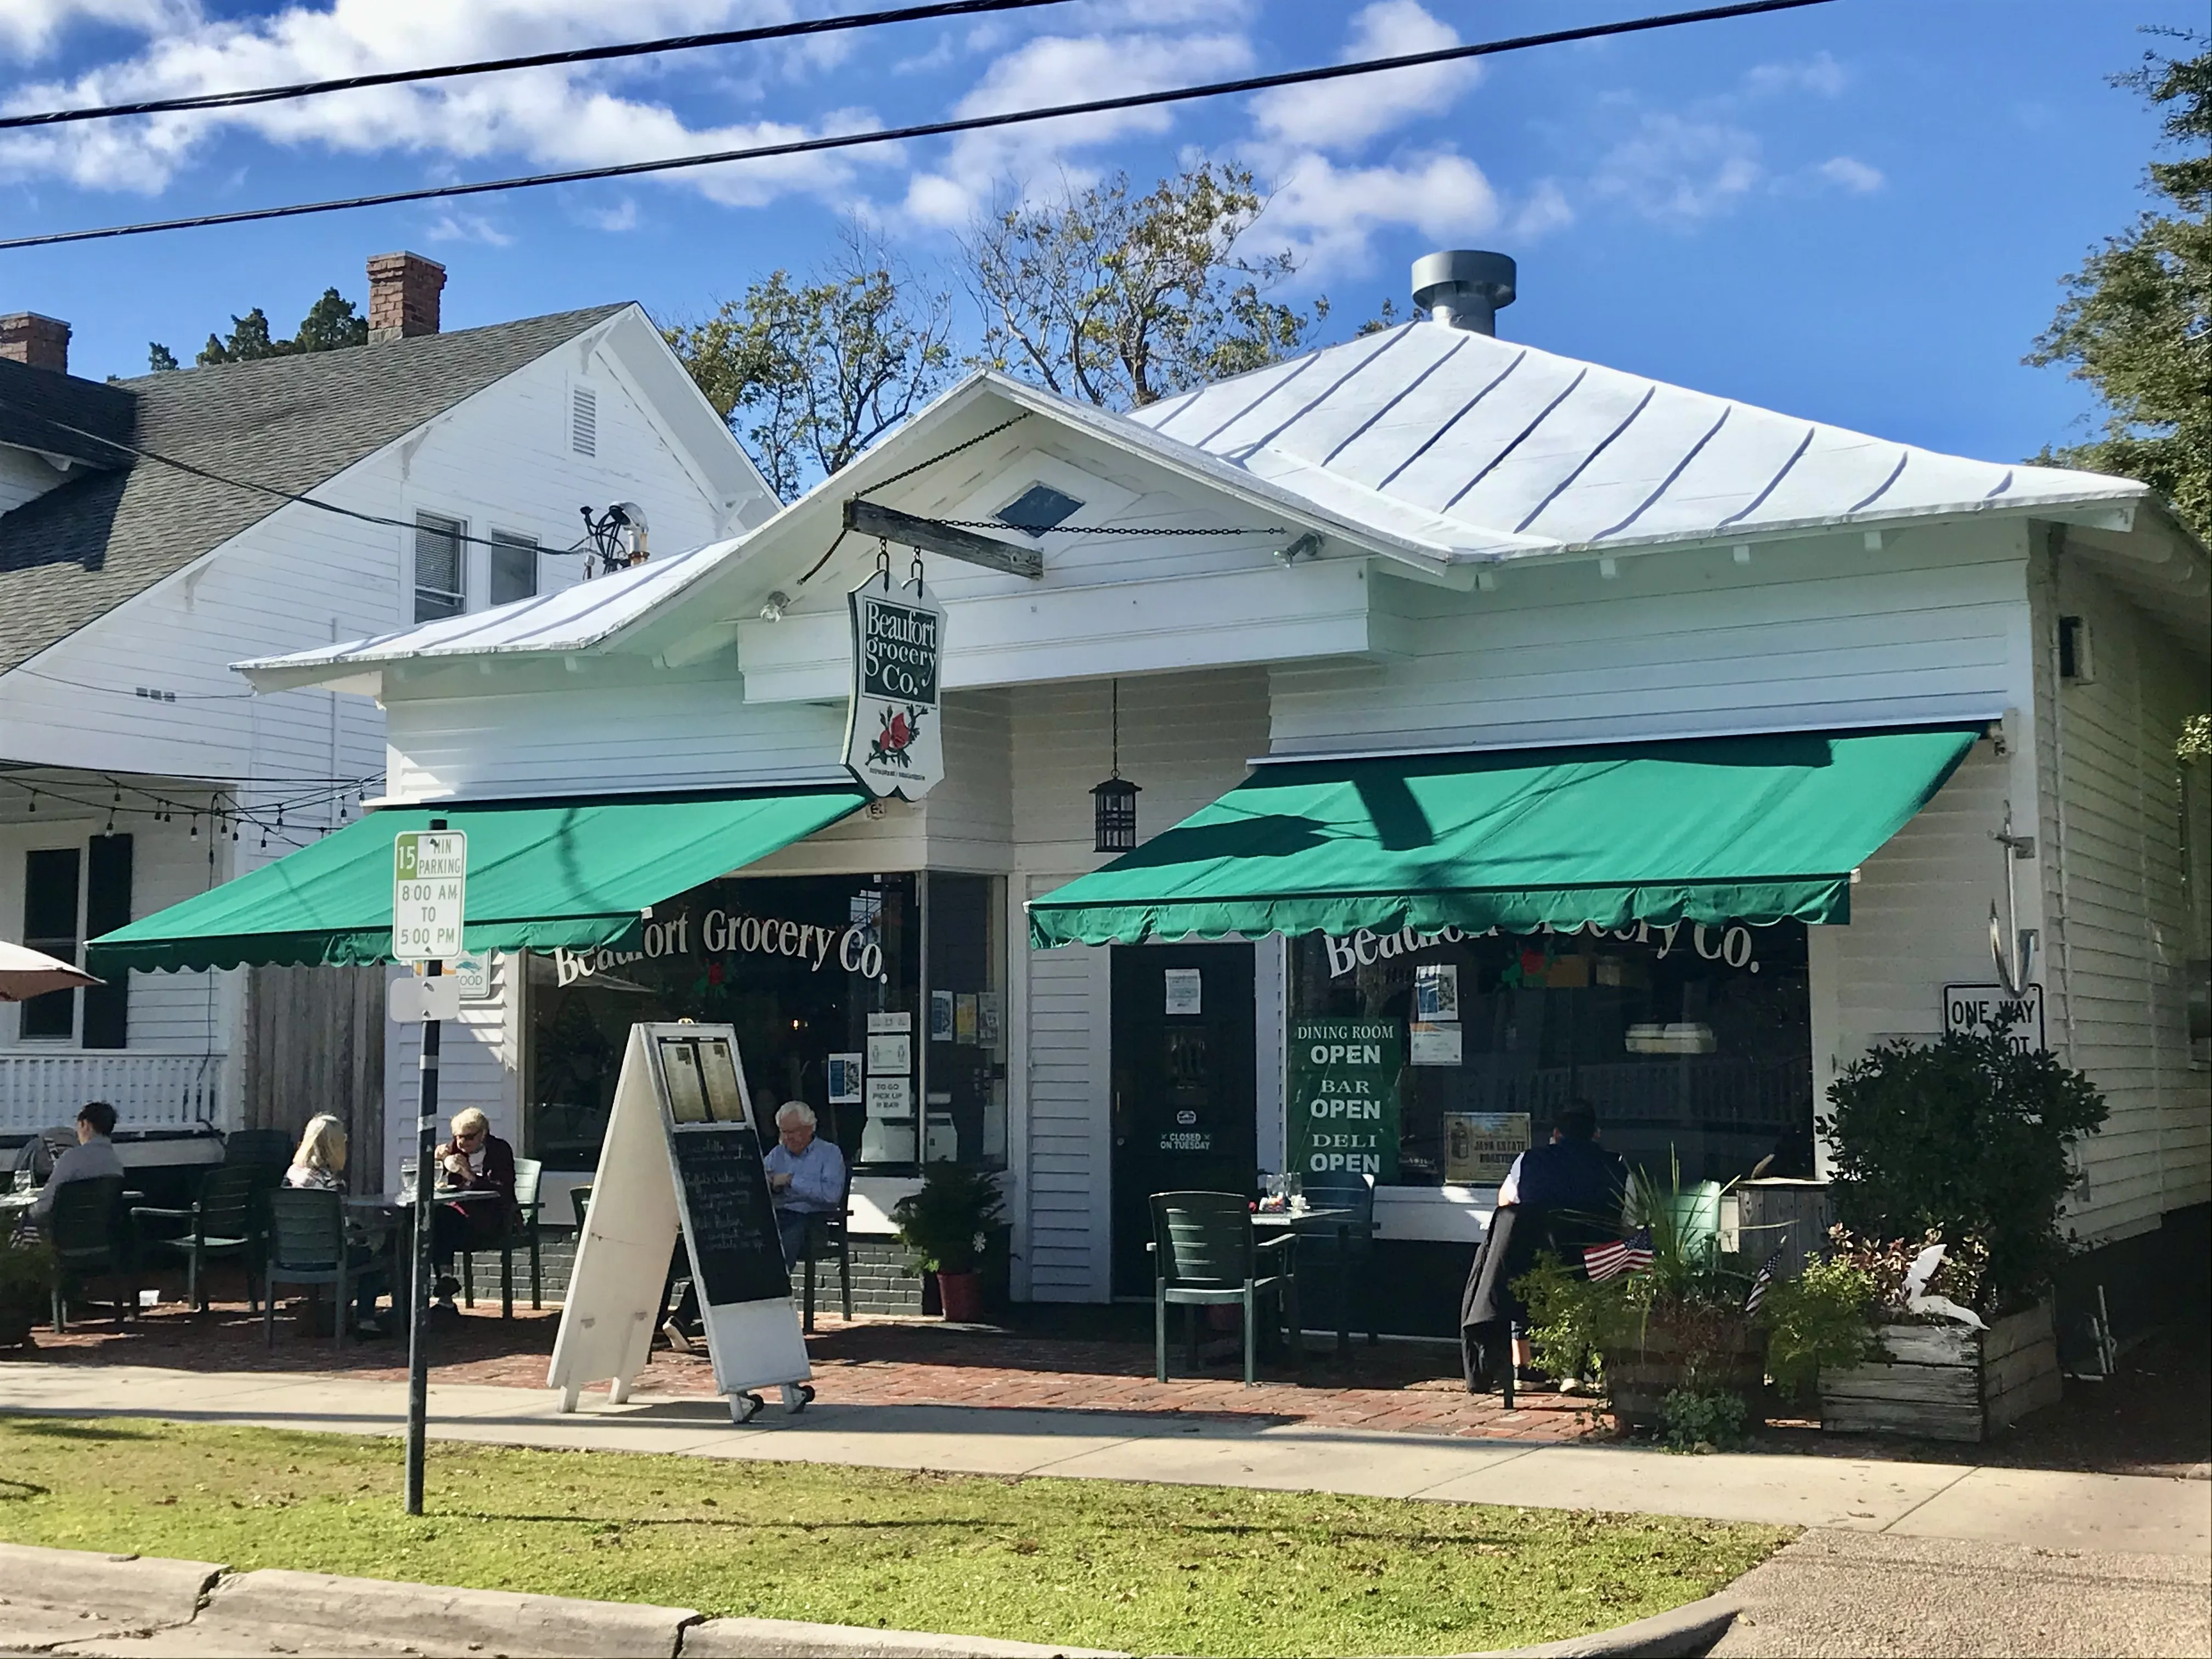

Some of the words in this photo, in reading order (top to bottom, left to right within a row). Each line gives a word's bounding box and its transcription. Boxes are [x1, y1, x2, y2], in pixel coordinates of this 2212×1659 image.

[867, 602, 935, 648] Beaufort
[865, 637, 936, 687] grocery
[882, 664, 918, 695] Co.
[433, 838, 452, 854] MIN
[398, 845, 416, 870] 15
[419, 858, 461, 874] PARKING
[402, 884, 431, 901] 8:00
[438, 884, 457, 900] AM
[421, 906, 436, 922] TO
[400, 928, 430, 945] 5:00
[437, 928, 455, 944] PM
[555, 913, 688, 988] Beaort
[703, 909, 836, 972] Grocery
[840, 923, 888, 984] Co.
[456, 975, 483, 986] OOD
[1952, 1001, 1989, 1025] ONE
[1297, 1026, 1347, 1039] DINING
[1352, 1025, 1394, 1039] ROOM
[1310, 1045, 1381, 1064] OPEN
[2008, 1036, 2030, 1057] OT
[1321, 1080, 1370, 1093] BAR
[1310, 1099, 1381, 1119] OPEN
[1169, 1132, 1201, 1141] CLOSED
[1312, 1133, 1376, 1147] DELI
[1160, 1141, 1172, 1149] ON
[1173, 1141, 1210, 1150] TUESDAY
[1310, 1153, 1380, 1173] OPEN
